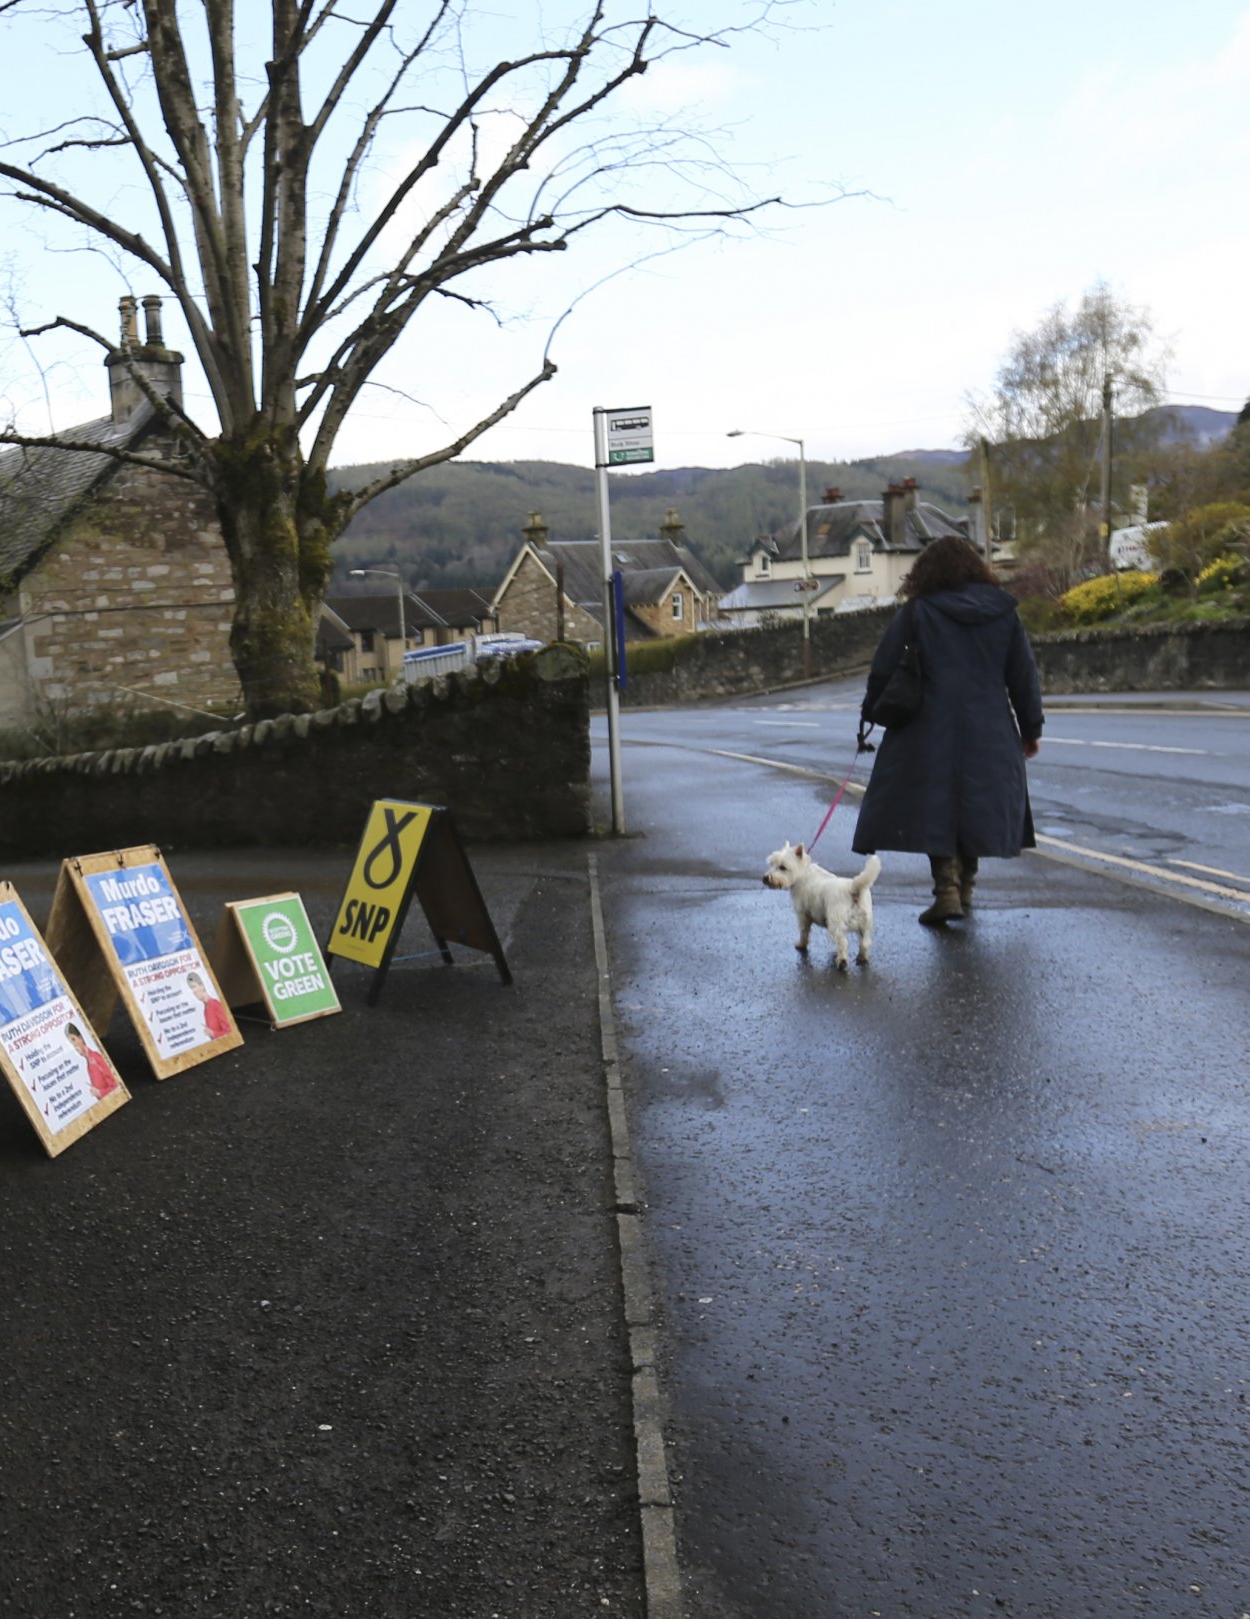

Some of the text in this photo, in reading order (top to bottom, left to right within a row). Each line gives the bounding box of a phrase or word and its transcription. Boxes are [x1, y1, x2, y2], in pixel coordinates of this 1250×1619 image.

[98, 873, 160, 902] Murdo
[102, 896, 181, 934] FRASER
[338, 898, 390, 943] SNP
[128, 966, 148, 978] RUTH
[179, 954, 192, 963] FOR
[132, 961, 200, 988] A STRONG OPPOSITION
[264, 952, 318, 980] VOTE
[274, 972, 326, 1000] GREEN
[1, 1002, 65, 1042] RUTH DAVIDSON FOR
[8, 1044, 15, 1054] A
[13, 1030, 41, 1050] STRONG
